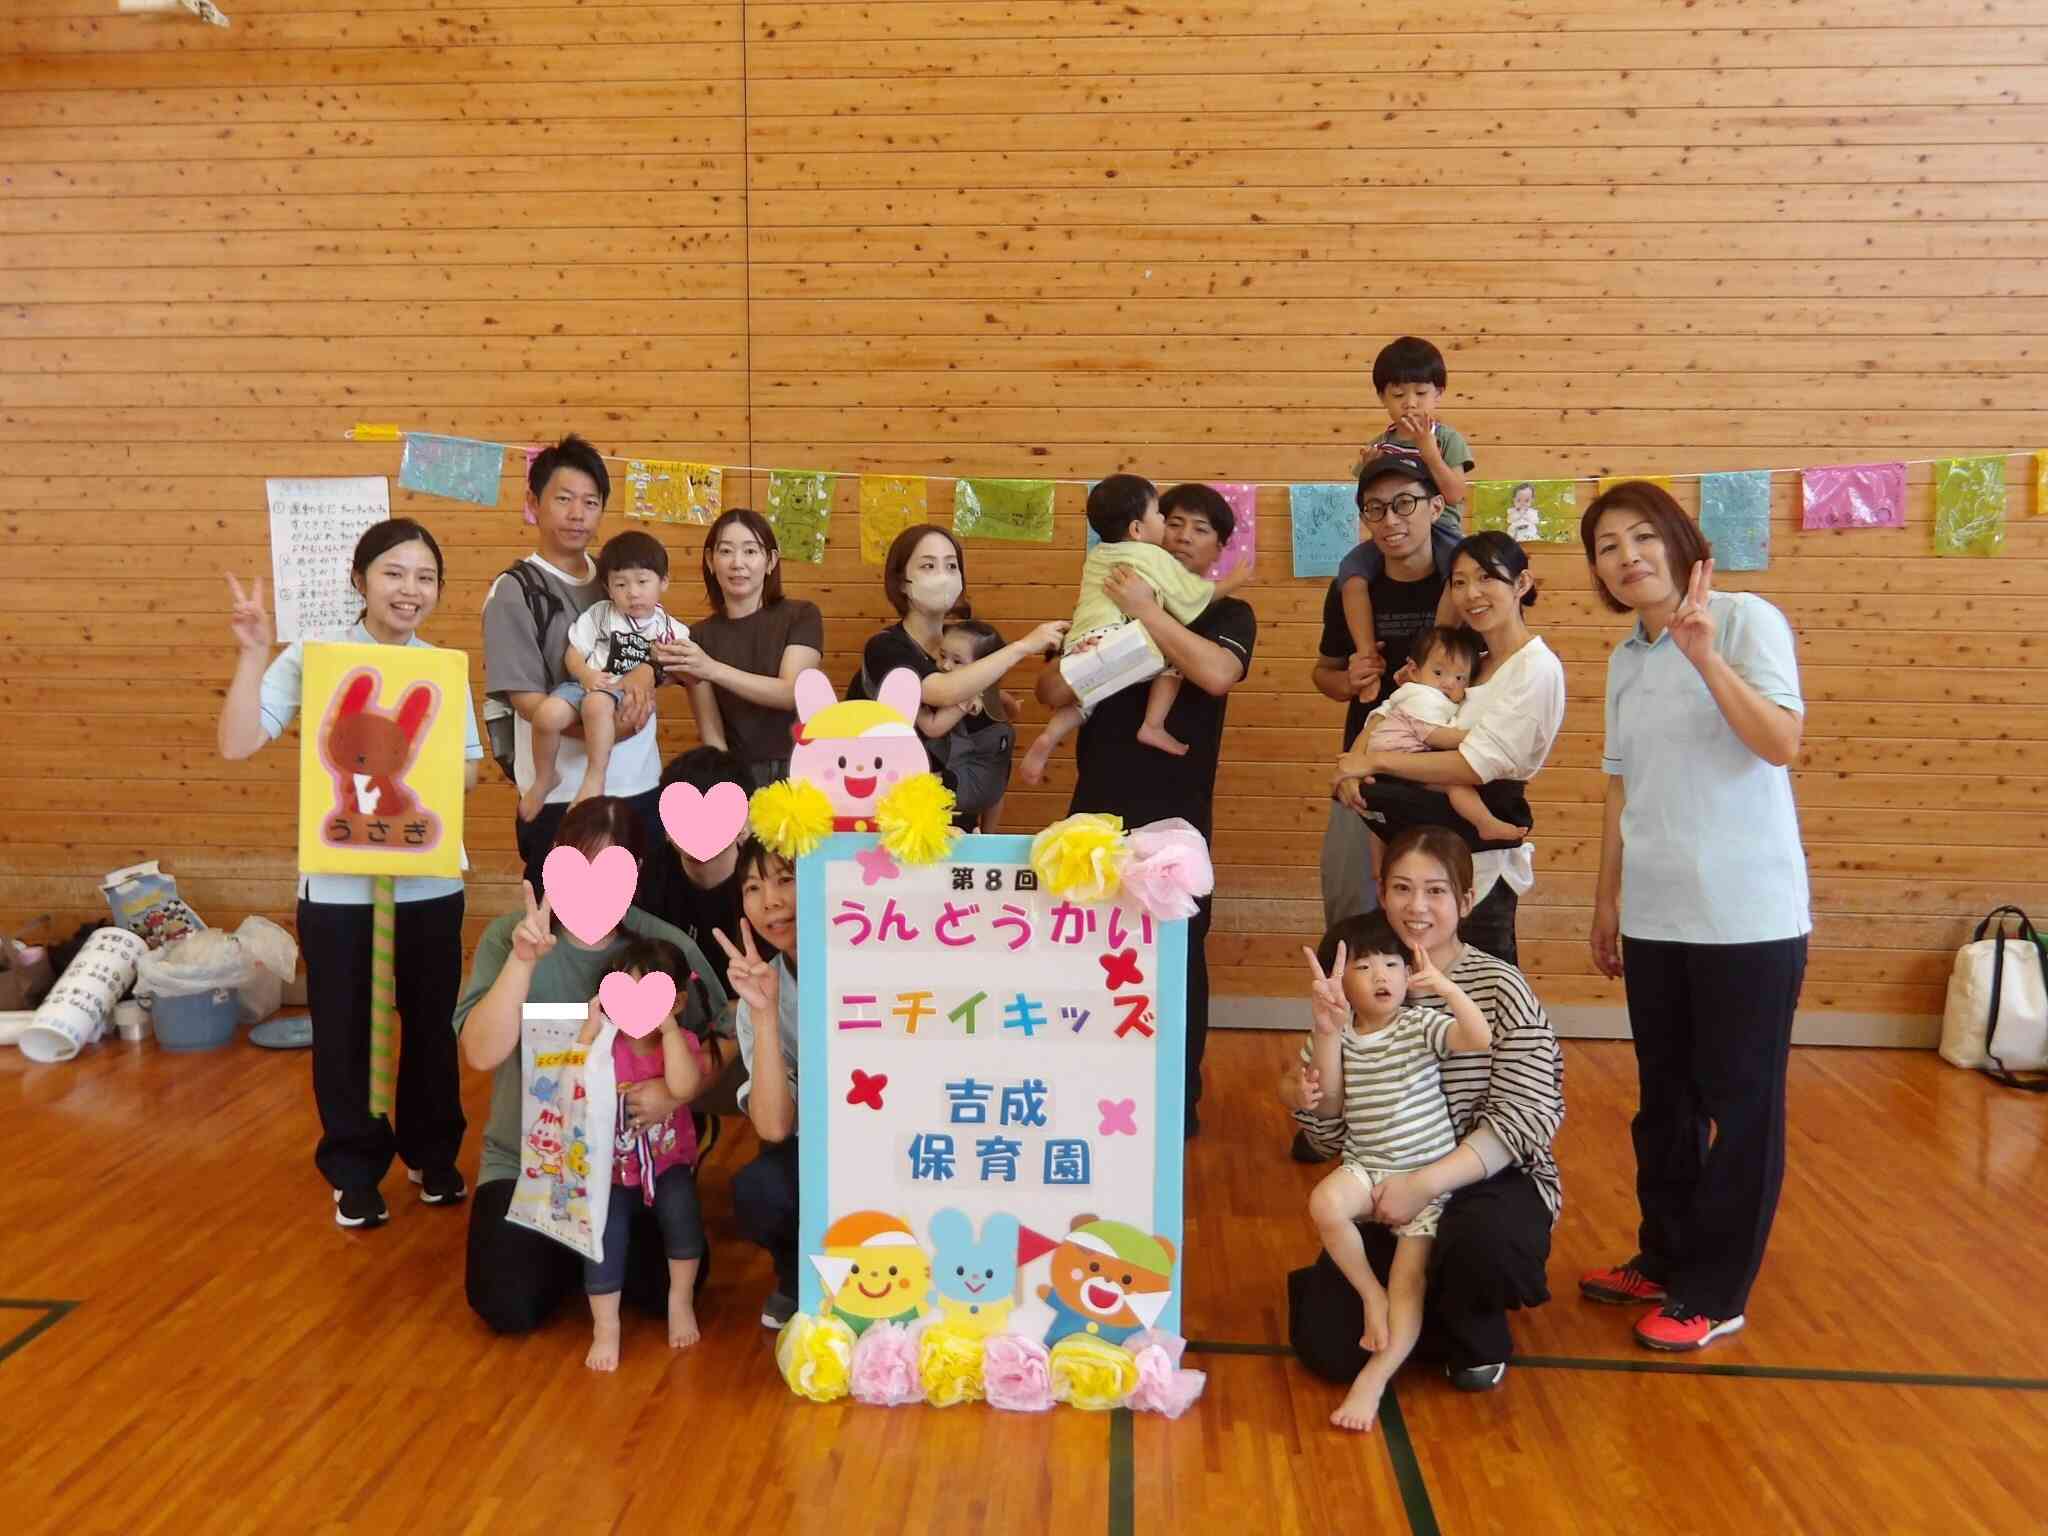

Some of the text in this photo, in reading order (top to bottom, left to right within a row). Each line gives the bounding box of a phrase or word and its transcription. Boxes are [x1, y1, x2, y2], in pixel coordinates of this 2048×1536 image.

[329, 819, 428, 844] うさぎ
[951, 867, 1038, 891] 第8回
[832, 899, 1152, 950] うんどうかい
[838, 991, 1154, 1039] ニチイキッズ
[945, 1078, 1047, 1127] 吉成
[908, 1133, 1090, 1184] 保育園
